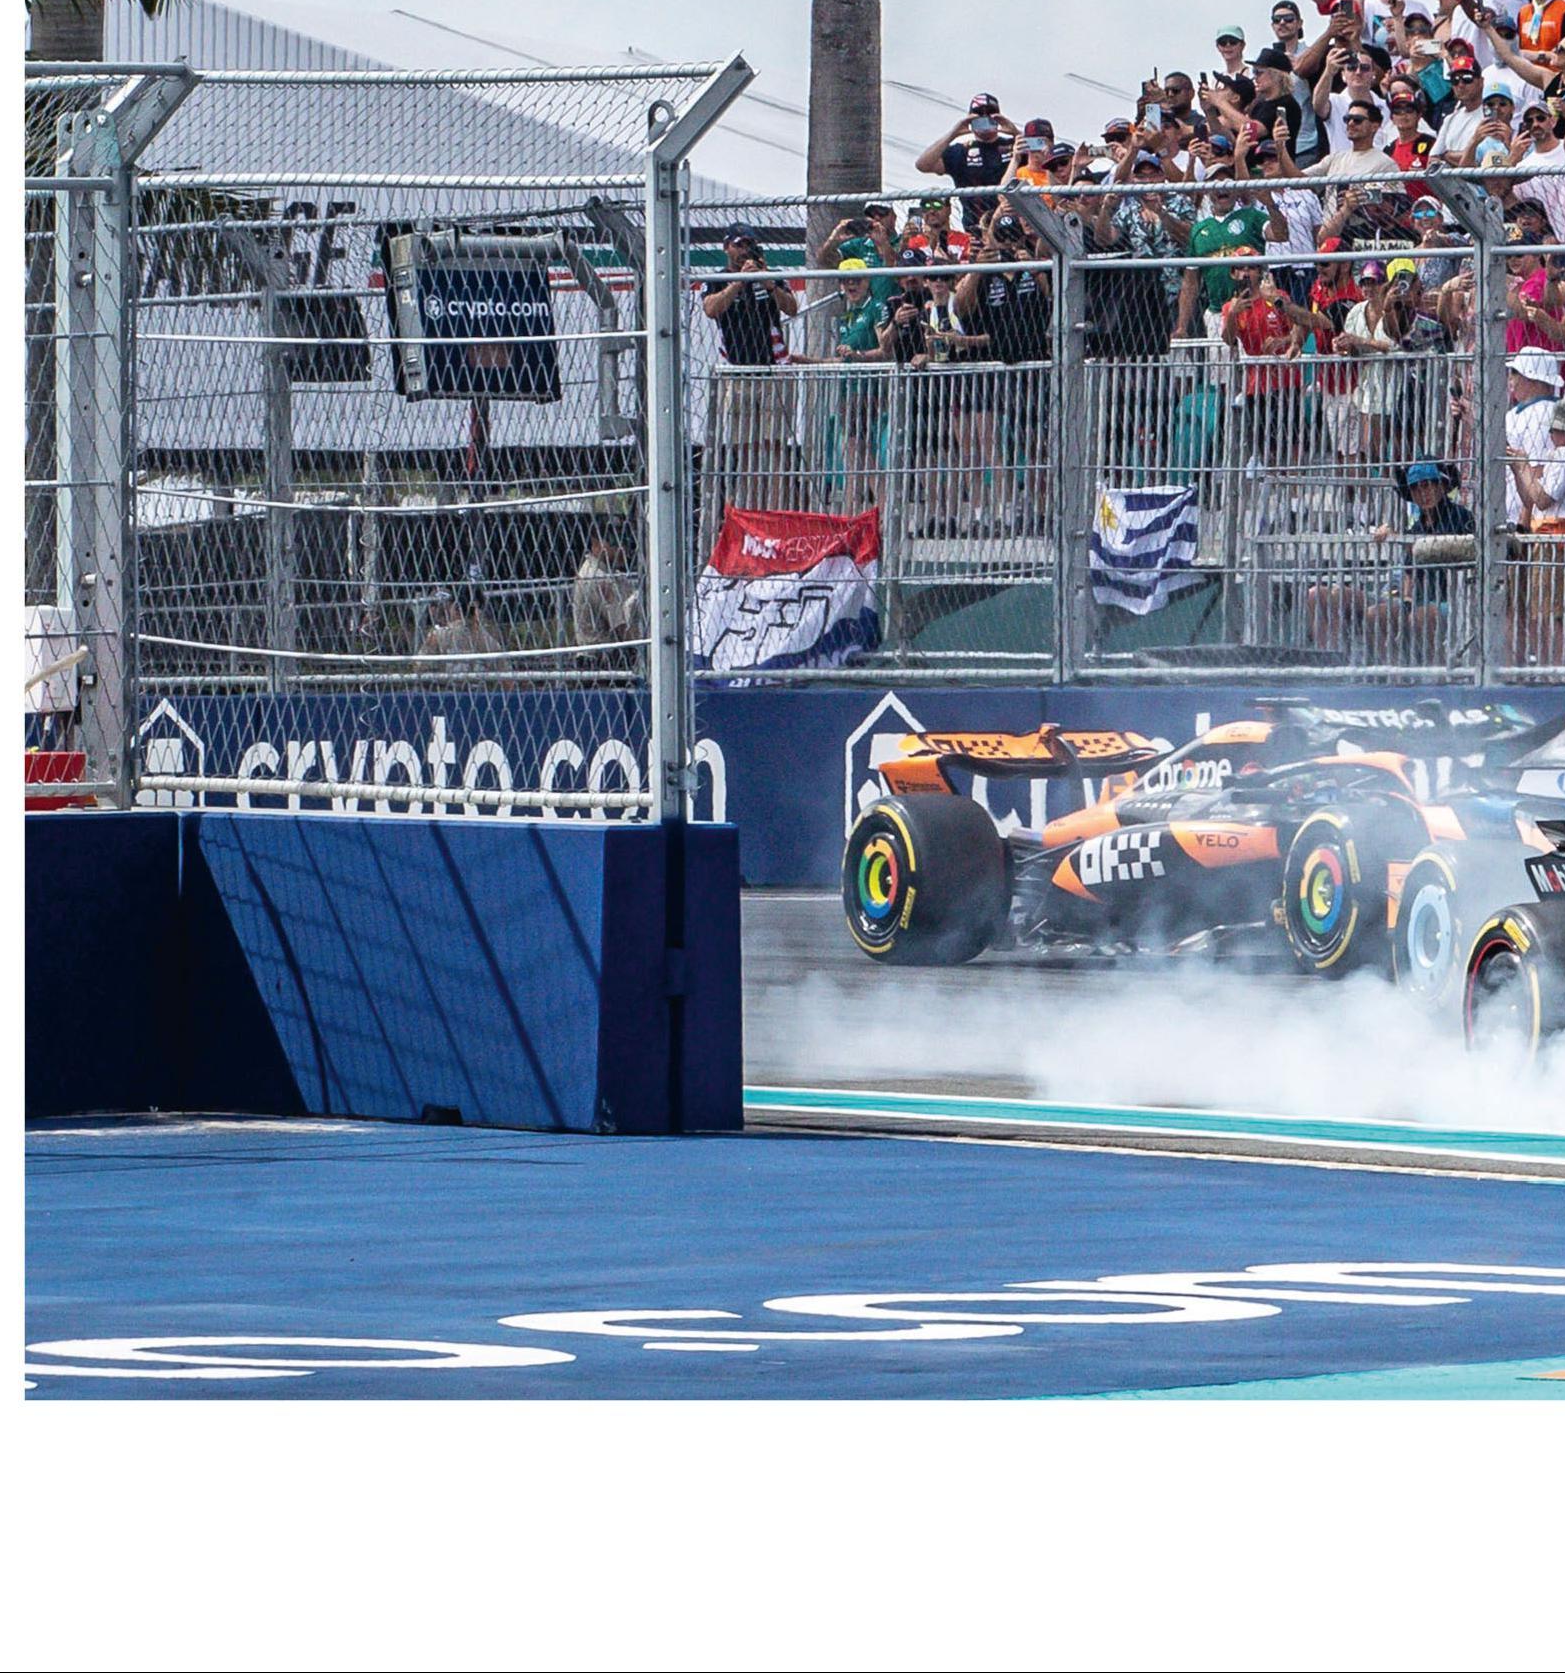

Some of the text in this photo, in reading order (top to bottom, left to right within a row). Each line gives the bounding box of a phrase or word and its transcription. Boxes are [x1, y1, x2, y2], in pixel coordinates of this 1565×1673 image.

[447, 297, 549, 319] crypto.com
[235, 715, 727, 822] cryptocom
[1143, 757, 1233, 793] Chrome
[1194, 833, 1240, 850] VELO
